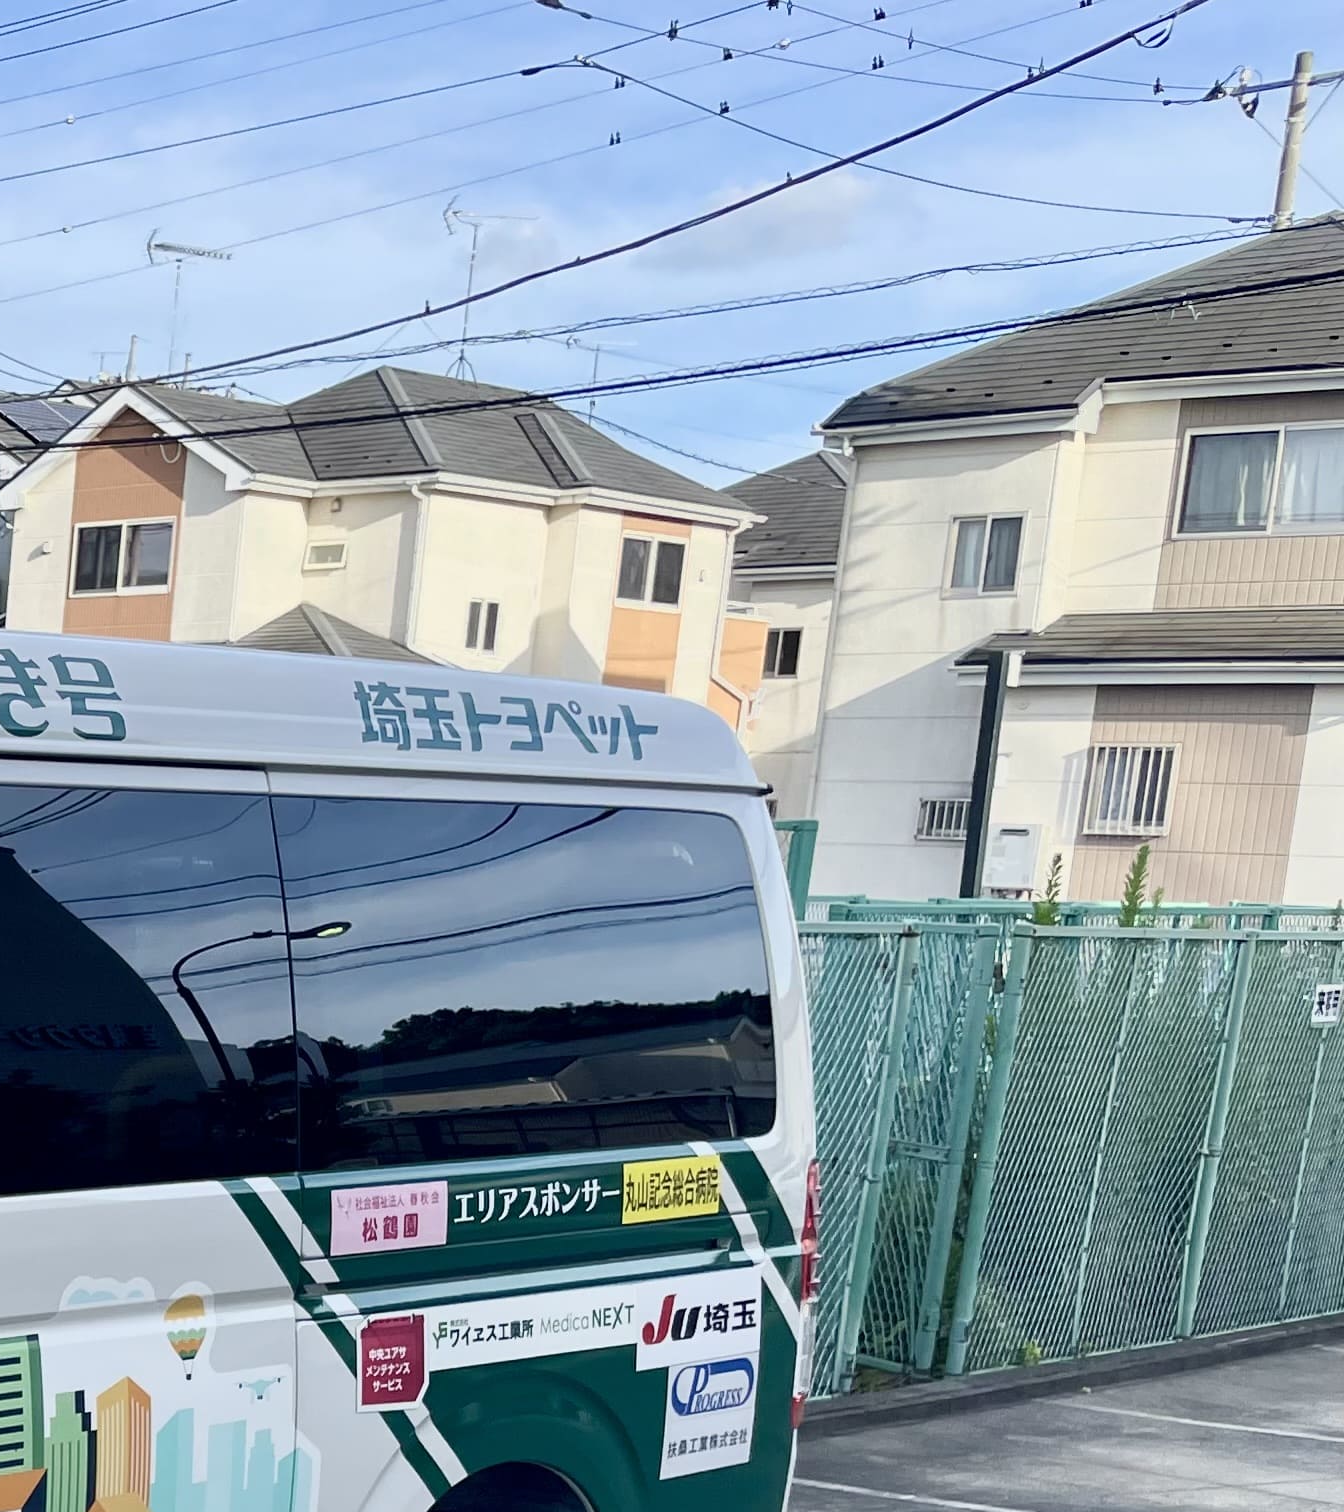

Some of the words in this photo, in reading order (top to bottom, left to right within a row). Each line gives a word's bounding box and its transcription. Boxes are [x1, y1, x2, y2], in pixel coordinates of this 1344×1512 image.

[354, 680, 659, 760] 埼玉トヨペット
[453, 1178, 620, 1223] エリアスポンサー
[625, 1165, 719, 1213] 丸山記念総合病院
[365, 1362, 411, 1378] メンテナンス
[373, 1378, 403, 1392] サービス
